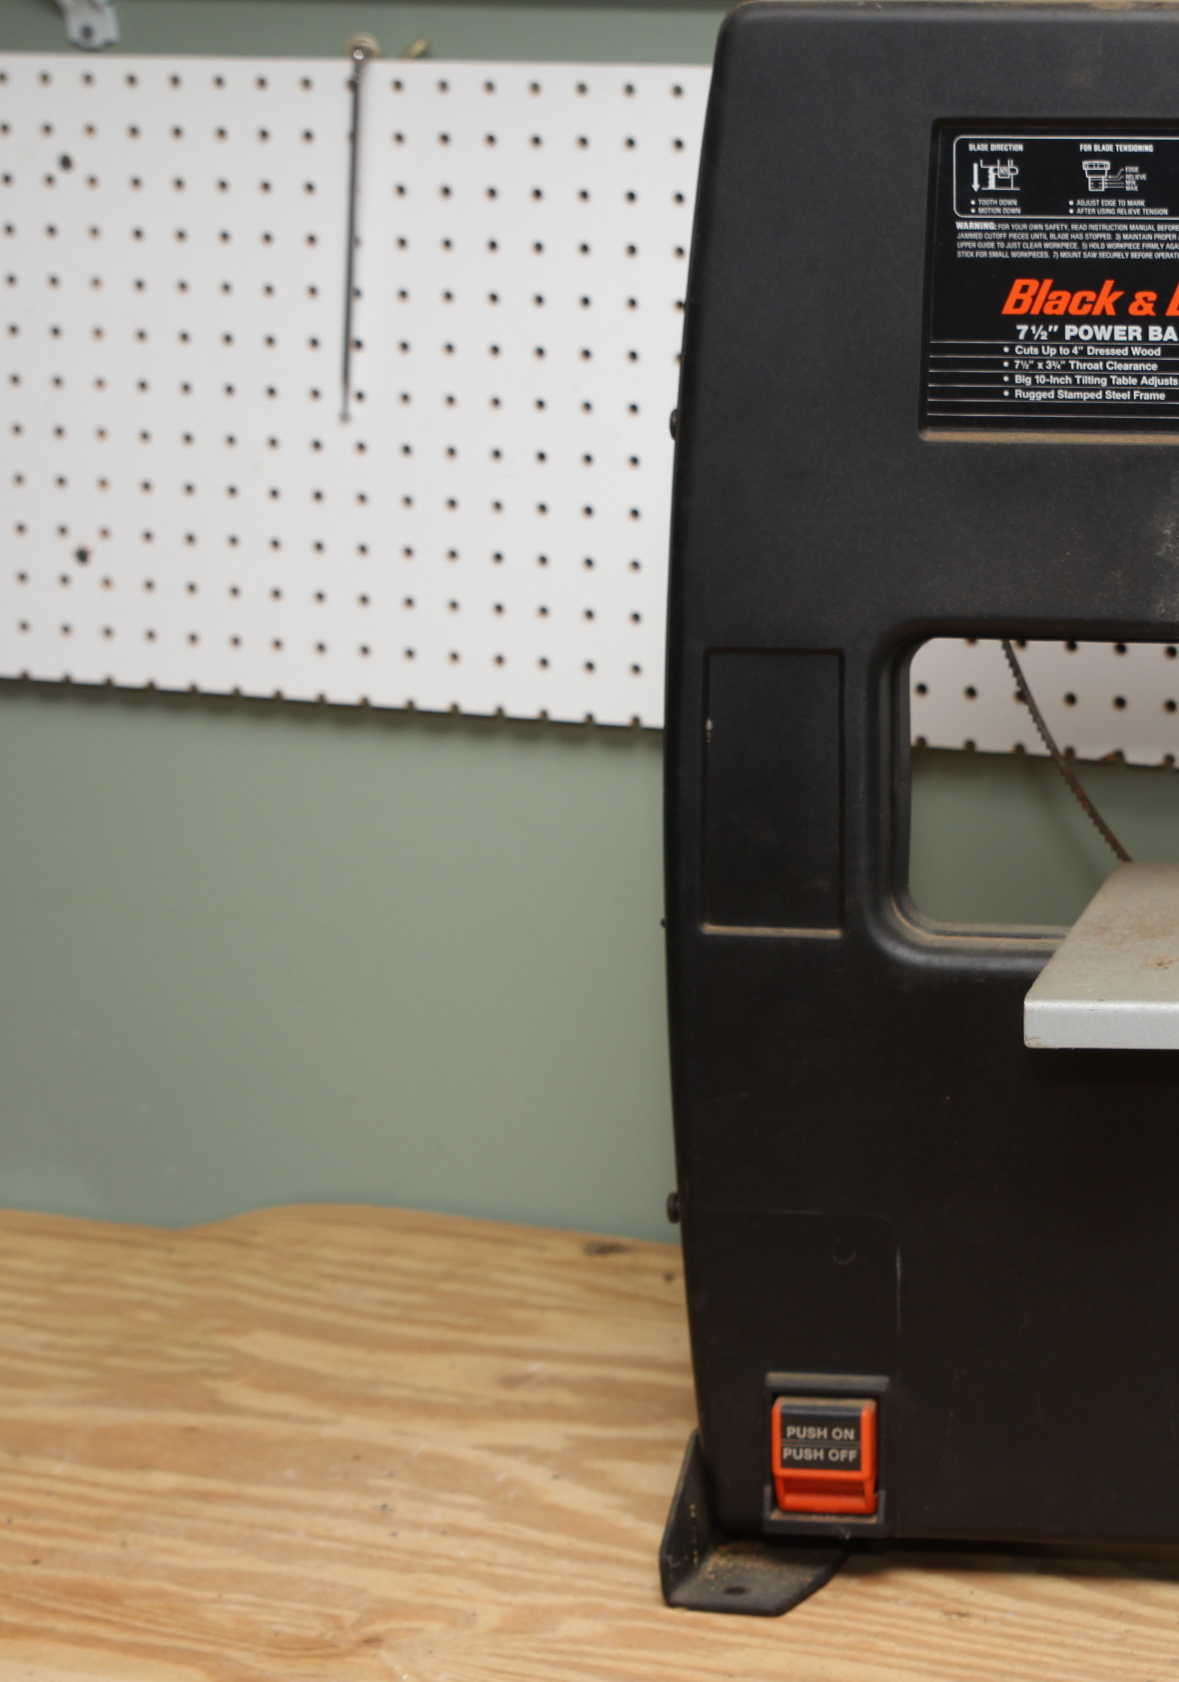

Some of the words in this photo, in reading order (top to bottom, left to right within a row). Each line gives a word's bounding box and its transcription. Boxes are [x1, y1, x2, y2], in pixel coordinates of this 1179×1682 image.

[968, 143, 989, 151] BLADE
[990, 144, 1023, 152] DIRECTION
[1080, 144, 1092, 152] FOR
[1094, 144, 1113, 152] BLADE
[1115, 144, 1153, 152] TENSIONING
[955, 221, 996, 231] WARNING:
[998, 223, 1010, 231] FOR
[1011, 223, 1028, 231] YOUR
[1029, 223, 1044, 231] OWN
[1070, 223, 1088, 231] READ
[1088, 224, 1128, 232] INSTRUCTION
[1129, 224, 1156, 232] MANUAL
[1157, 224, 1179, 232] BEFORE
[984, 232, 1007, 240] CUTOFF
[1008, 232, 1029, 240] PIECES
[1030, 232, 1047, 240] UNTIL
[1049, 232, 1070, 240] BLADE
[1154, 233, 1176, 241] PROPER
[1082, 242, 1088, 250] 5)
[1089, 242, 1105, 250] HOLD
[1053, 251, 1058, 259] 7)
[1060, 251, 1081, 259] MOUNT
[1001, 279, 1125, 316] Black
[1128, 291, 1157, 316] &
[1064, 325, 1142, 341] POWER
[1015, 345, 1039, 355] Cuts
[1041, 346, 1057, 357] Up
[1059, 346, 1070, 355] to
[1087, 347, 1128, 356] Dressed
[1131, 347, 1161, 356] Wood
[1068, 361, 1103, 370] Throat
[1105, 361, 1158, 371] Clearance
[1014, 375, 1031, 386] Big
[1034, 375, 1072, 384] 10-Inch
[1074, 375, 1107, 387] Tilting
[1110, 376, 1137, 385] Table
[1140, 376, 1178, 387] Adjusts
[1014, 389, 1054, 401] Rugged
[1057, 390, 1102, 401] Stamped
[1105, 390, 1130, 400] Steel
[1133, 391, 1165, 400] Frame
[786, 1425, 828, 1439] PUSH
[831, 1427, 855, 1441] ON
[782, 1447, 824, 1461] PUSH
[828, 1449, 858, 1462] OFF
